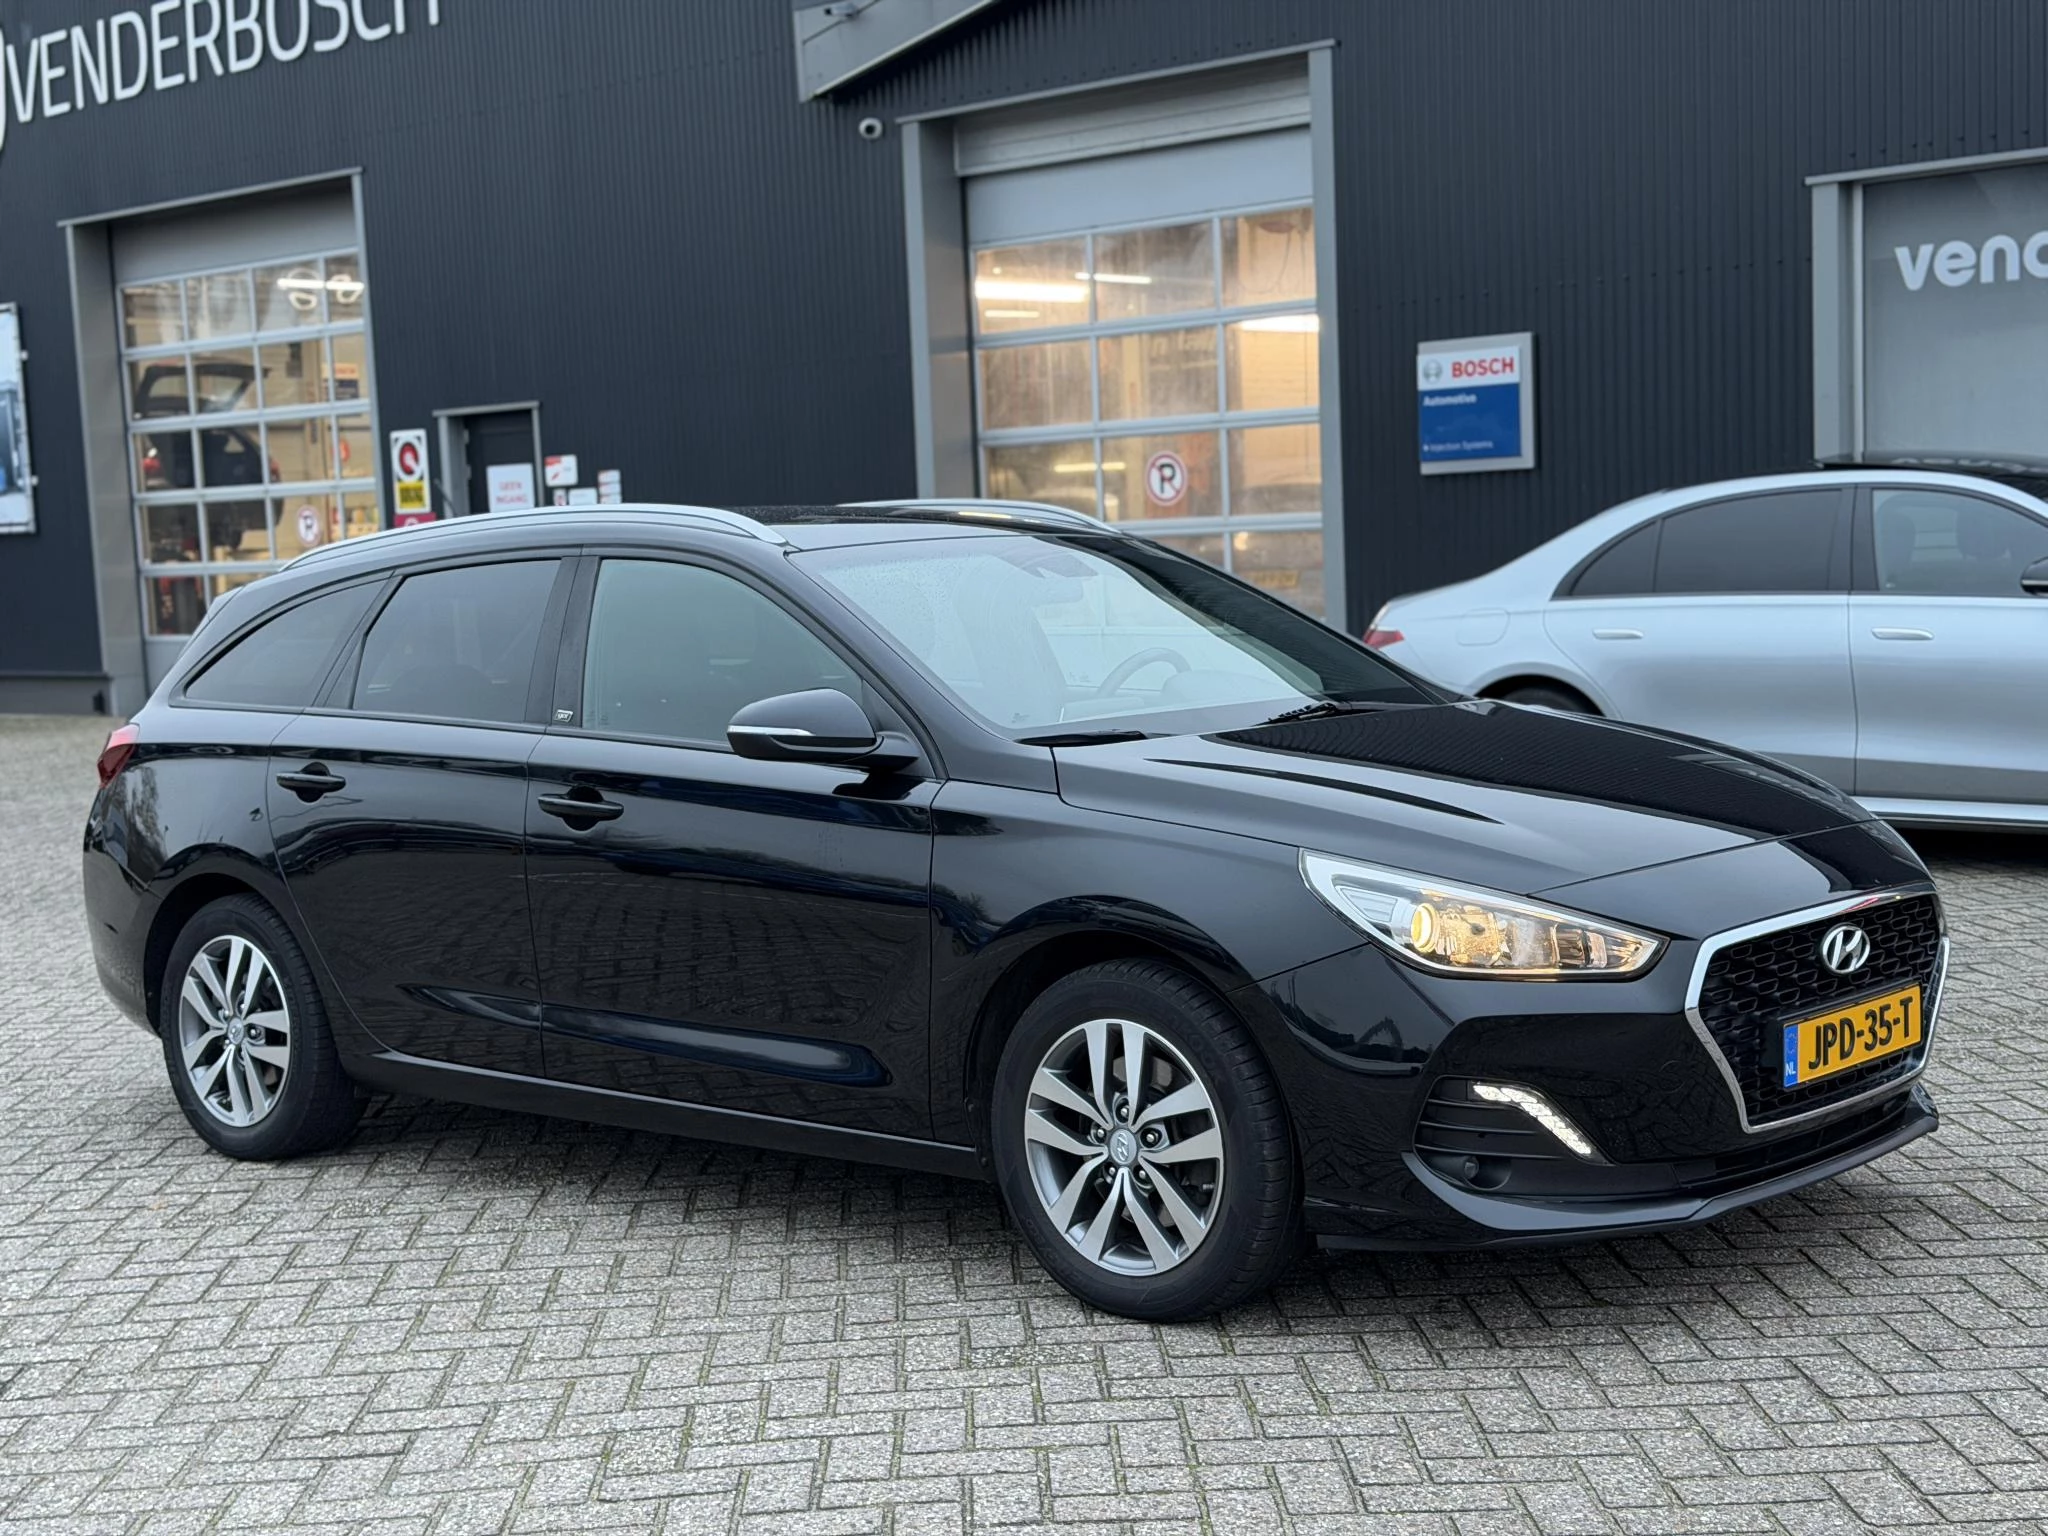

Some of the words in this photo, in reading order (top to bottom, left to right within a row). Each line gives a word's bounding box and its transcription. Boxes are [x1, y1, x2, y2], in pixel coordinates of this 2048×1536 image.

[1451, 356, 1515, 378] BOSCH
[1423, 393, 1478, 406] Automotive
[1808, 996, 1914, 1070] JPD-35-T
[1785, 1062, 1797, 1077] NL
